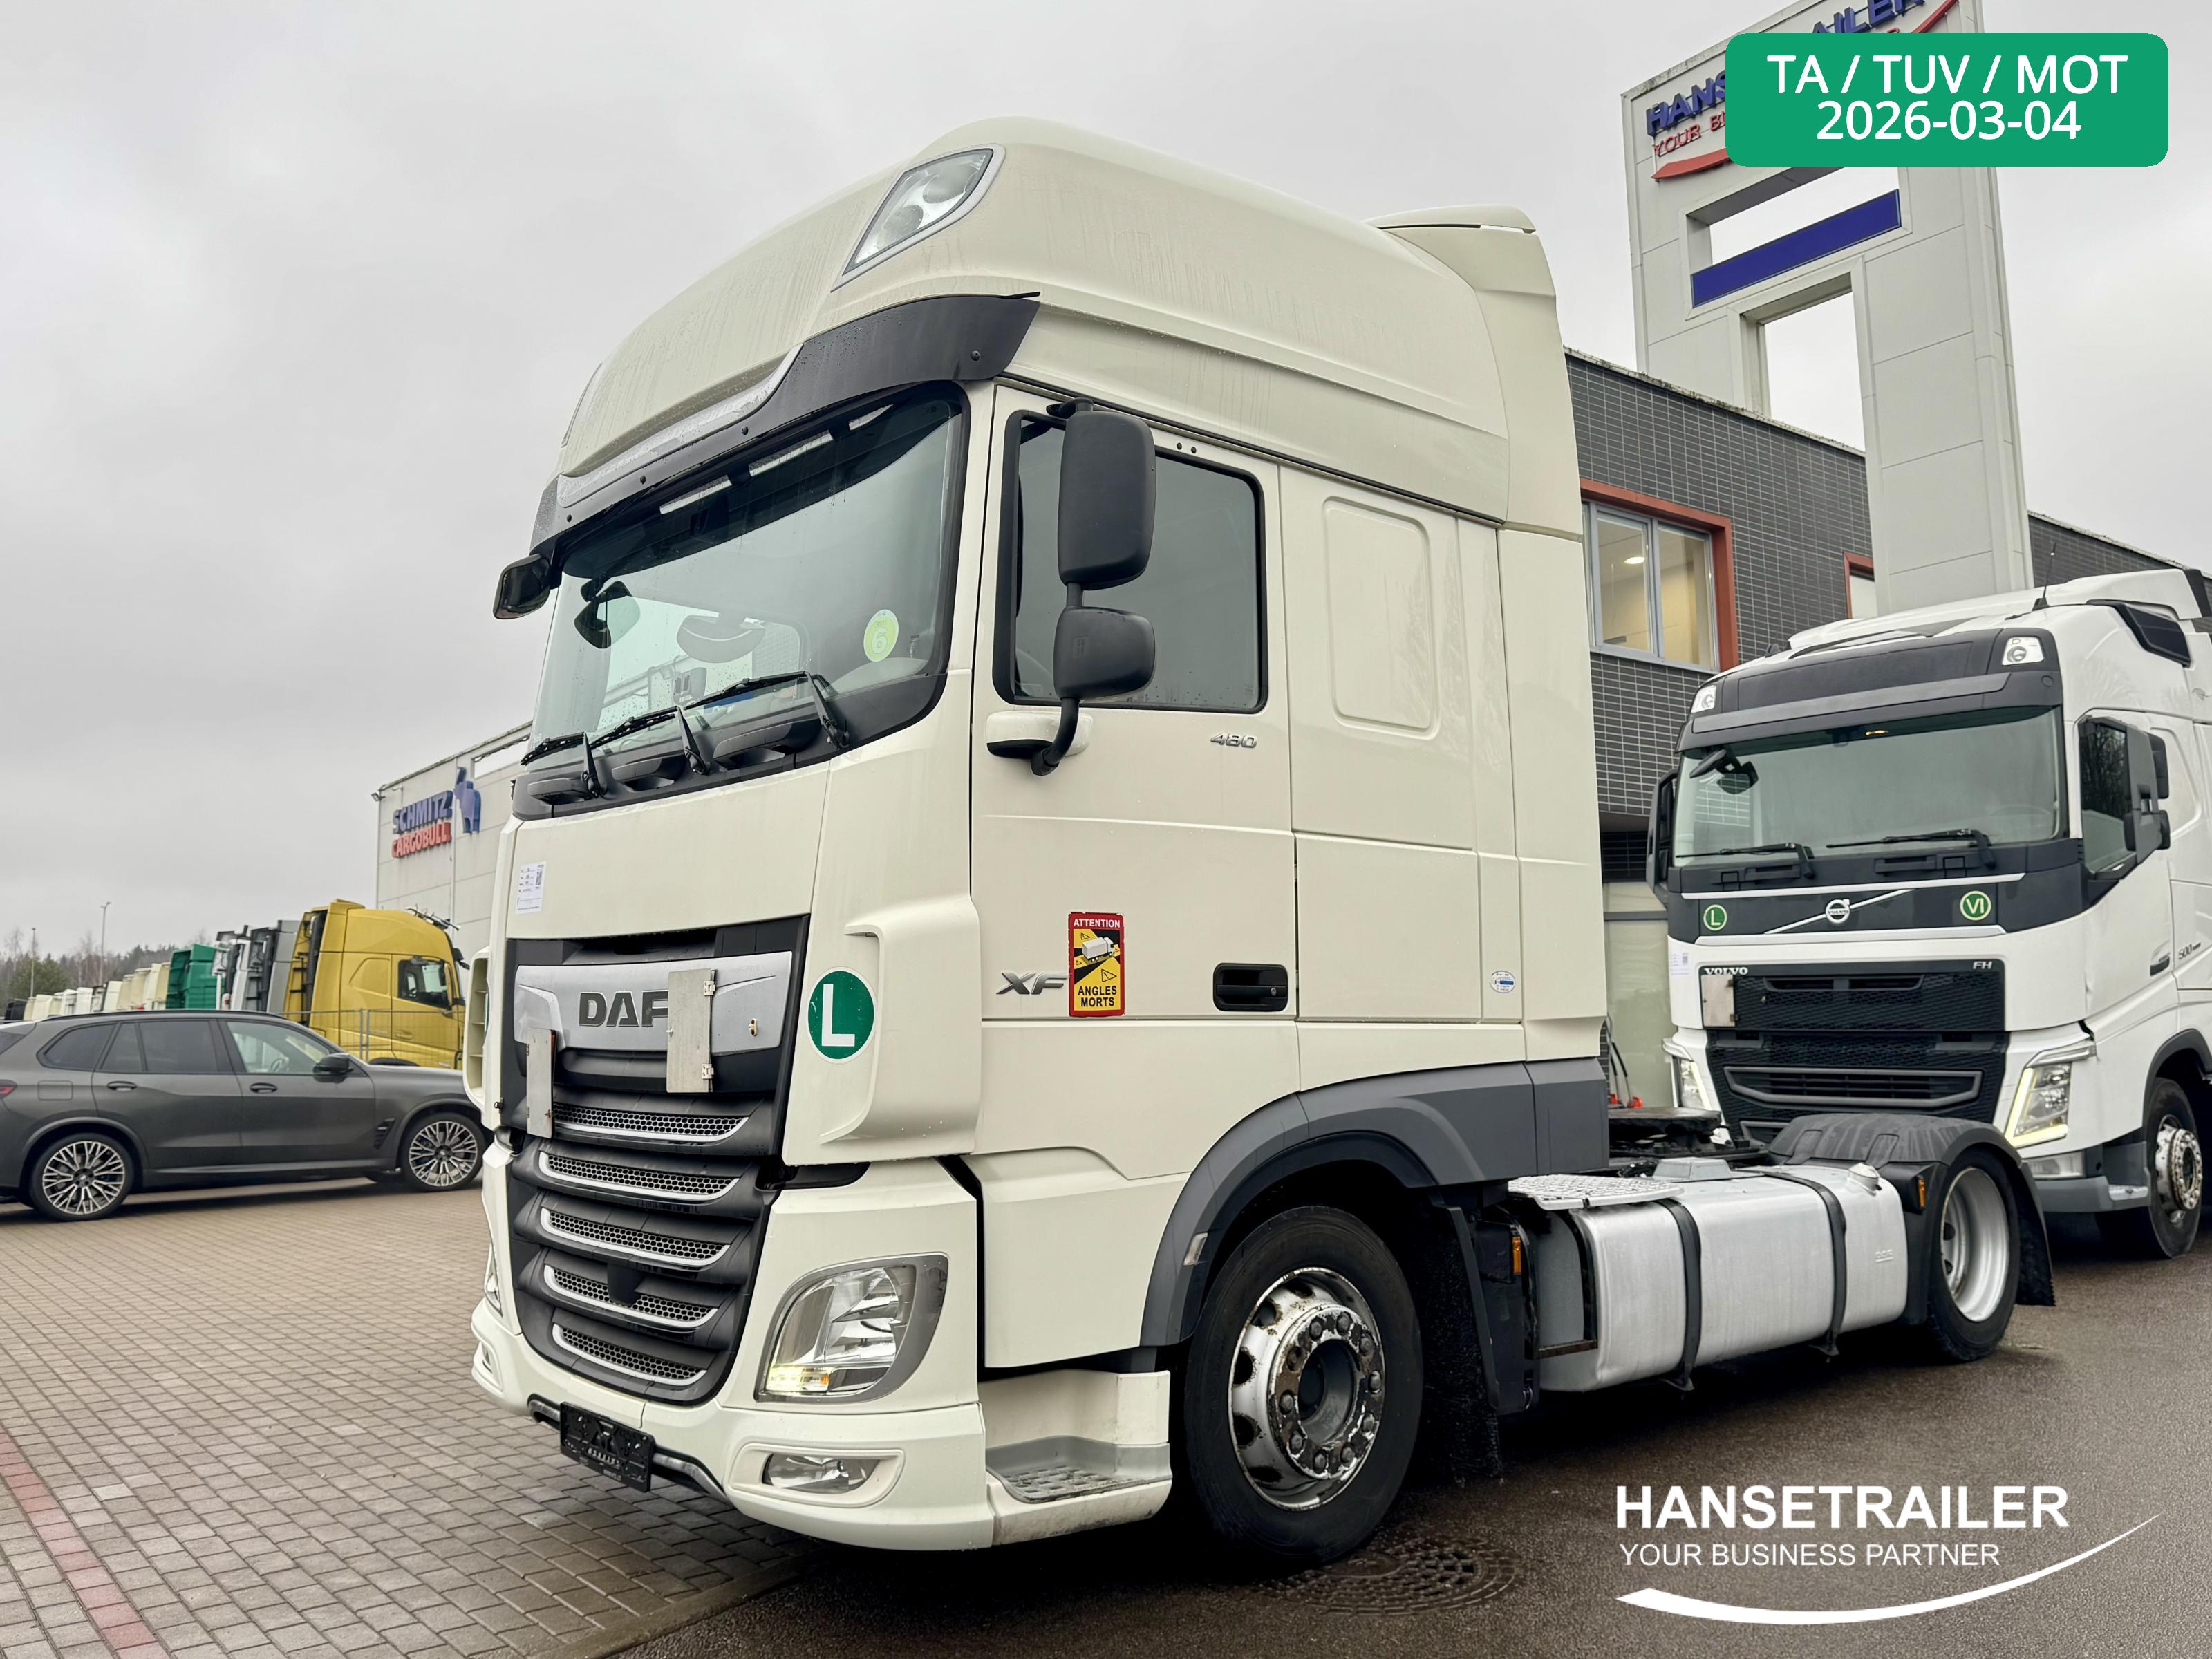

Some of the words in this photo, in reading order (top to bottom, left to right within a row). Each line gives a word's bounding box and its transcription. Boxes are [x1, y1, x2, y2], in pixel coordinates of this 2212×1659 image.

[1652, 124, 1702, 158] YOUR
[872, 627, 889, 655] 6
[1210, 733, 1257, 749] 480
[393, 790, 453, 835] SCHMITZ
[391, 822, 452, 858] CARGOBULL
[1965, 898, 1985, 915] VI
[1073, 919, 1121, 928] ATTENTION
[1711, 909, 1721, 926] L
[1704, 966, 1748, 975] VOLVO
[1972, 961, 1992, 970] FH
[995, 972, 1069, 995] XF
[1078, 986, 1117, 996] ANGLES
[579, 991, 668, 1027] DAF
[1080, 997, 1115, 1007] MORTS
[821, 982, 856, 1047] L
